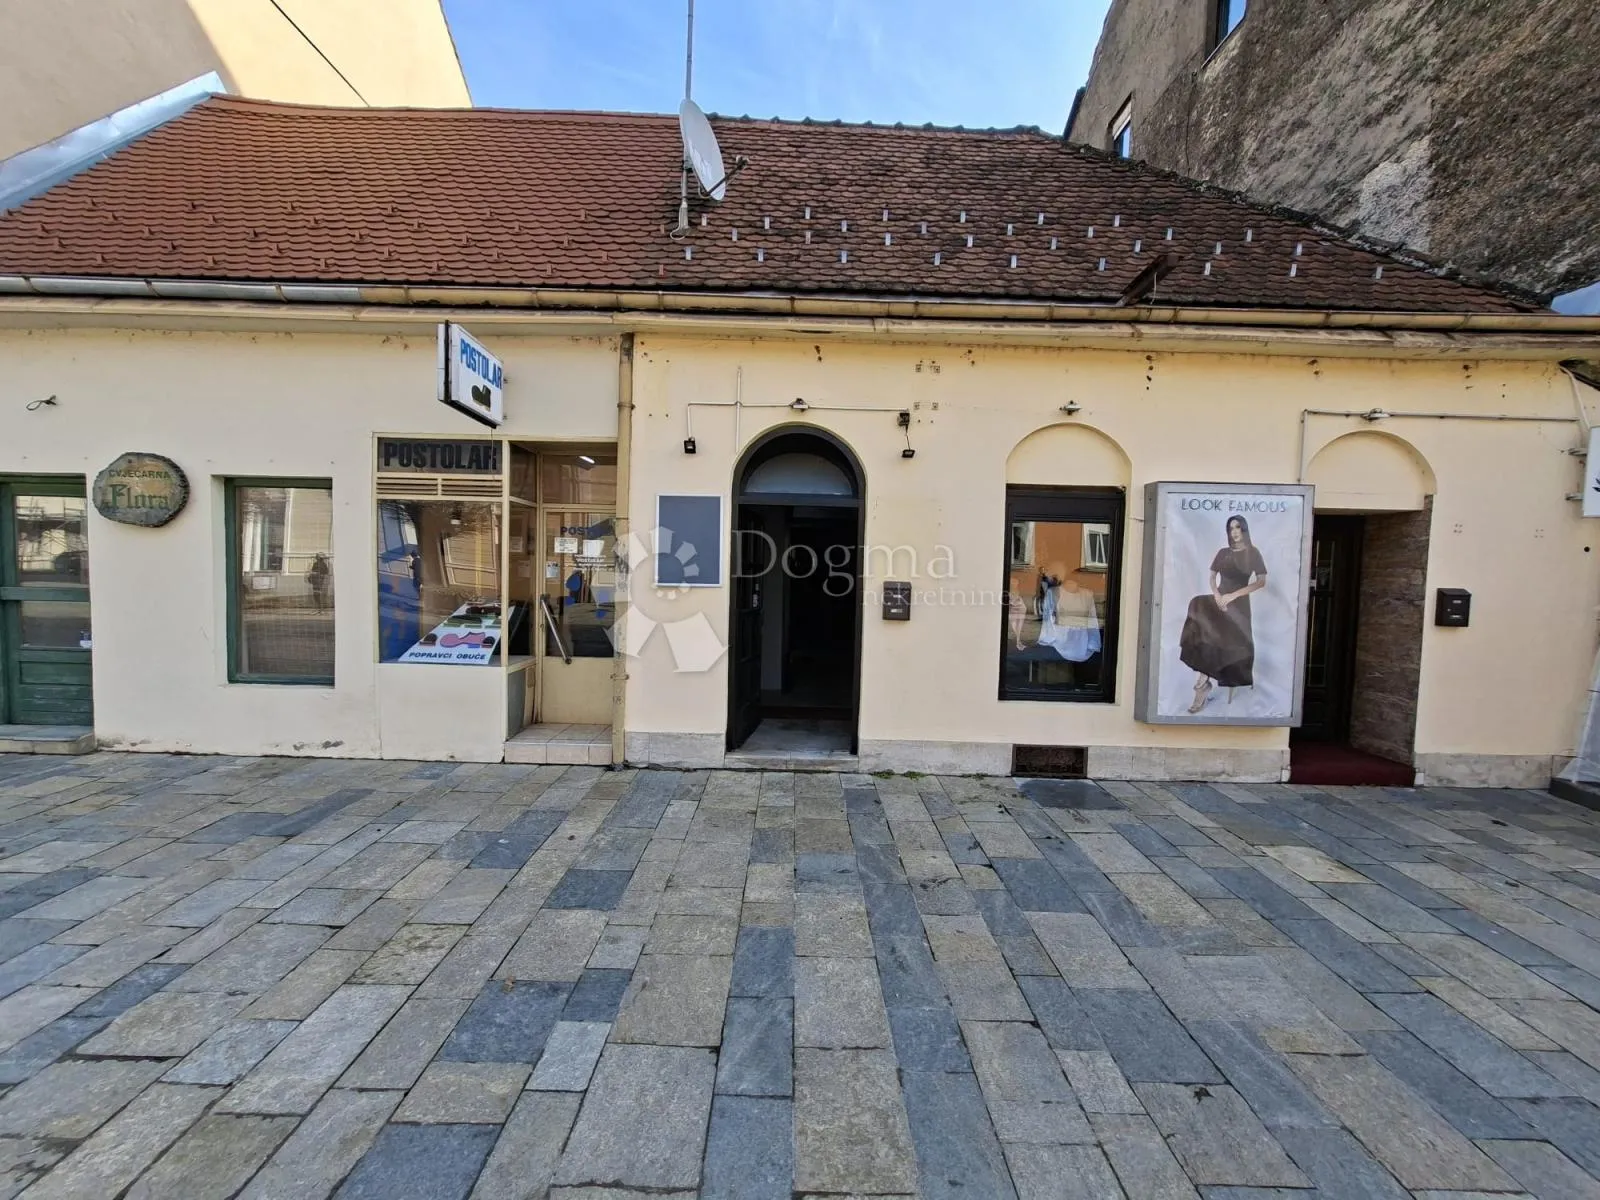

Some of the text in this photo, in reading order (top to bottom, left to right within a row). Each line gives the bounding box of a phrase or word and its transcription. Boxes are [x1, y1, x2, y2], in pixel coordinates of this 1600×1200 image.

[460, 338, 502, 390] POSTOLAR
[383, 442, 497, 470] POSTOLAR
[108, 483, 169, 509] Flora
[1181, 498, 1288, 513] LOOK FAMOUS
[408, 652, 453, 660] POPRAVCI
